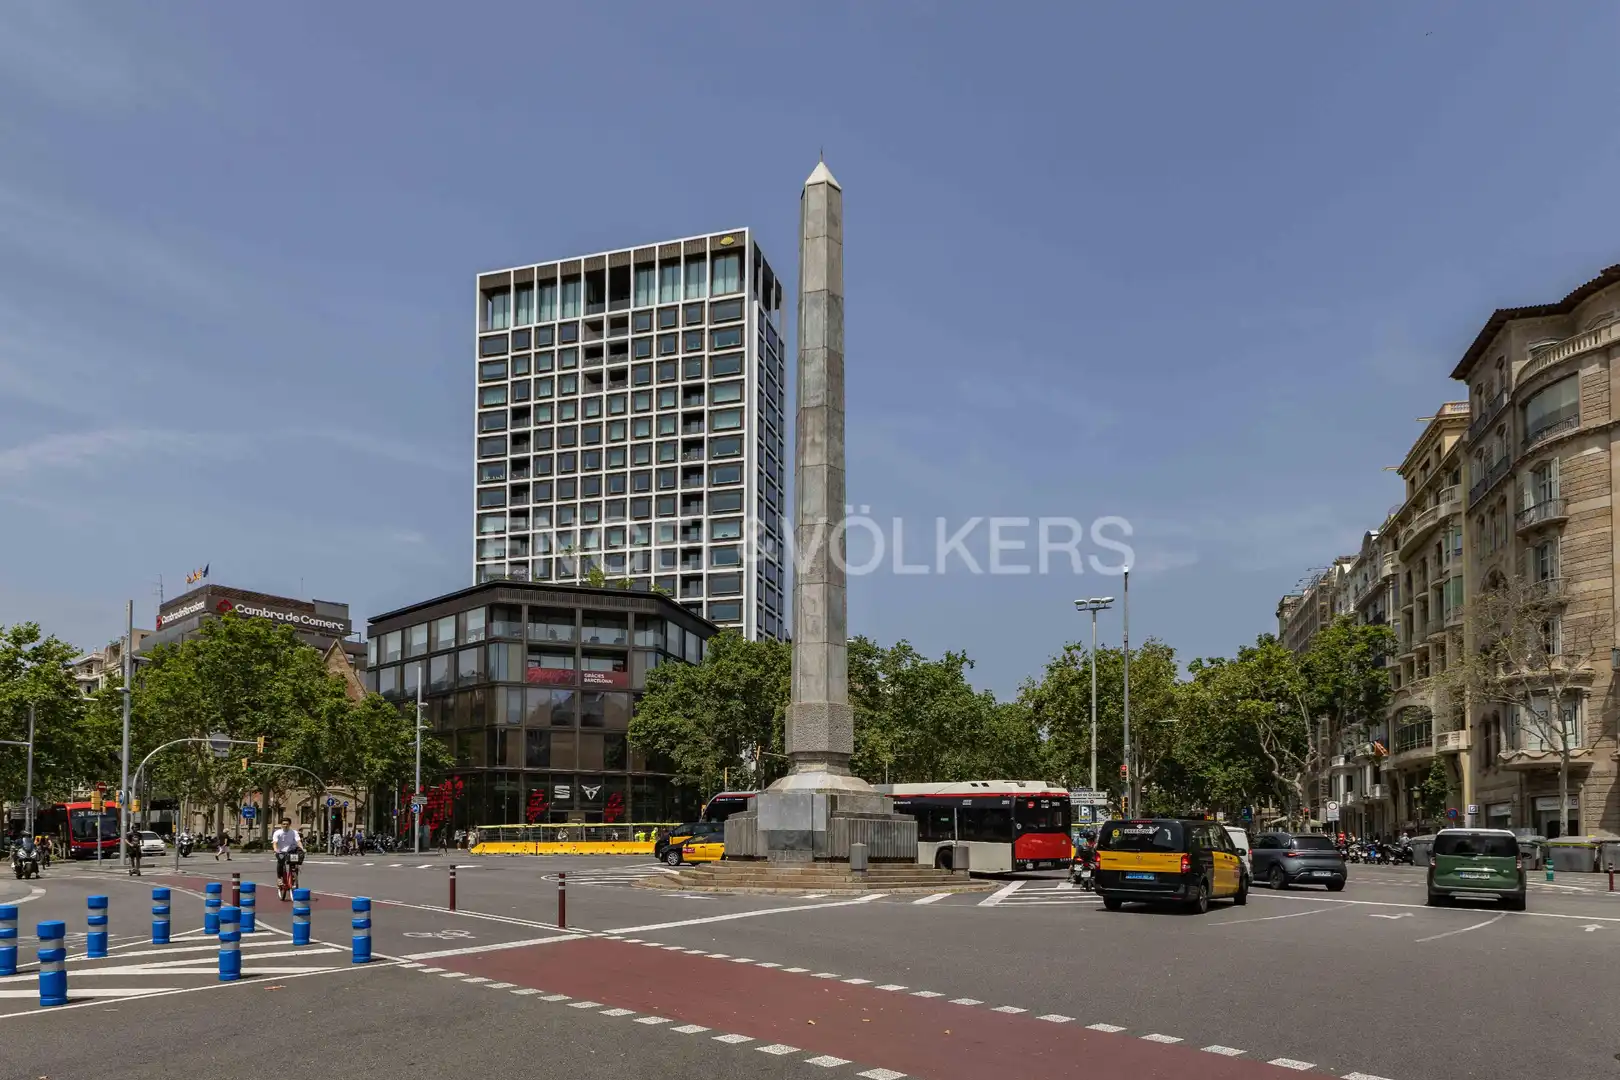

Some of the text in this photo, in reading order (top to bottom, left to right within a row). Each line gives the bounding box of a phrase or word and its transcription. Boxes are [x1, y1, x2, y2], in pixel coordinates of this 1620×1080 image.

[235, 604, 345, 633] Cambra de Comerç
